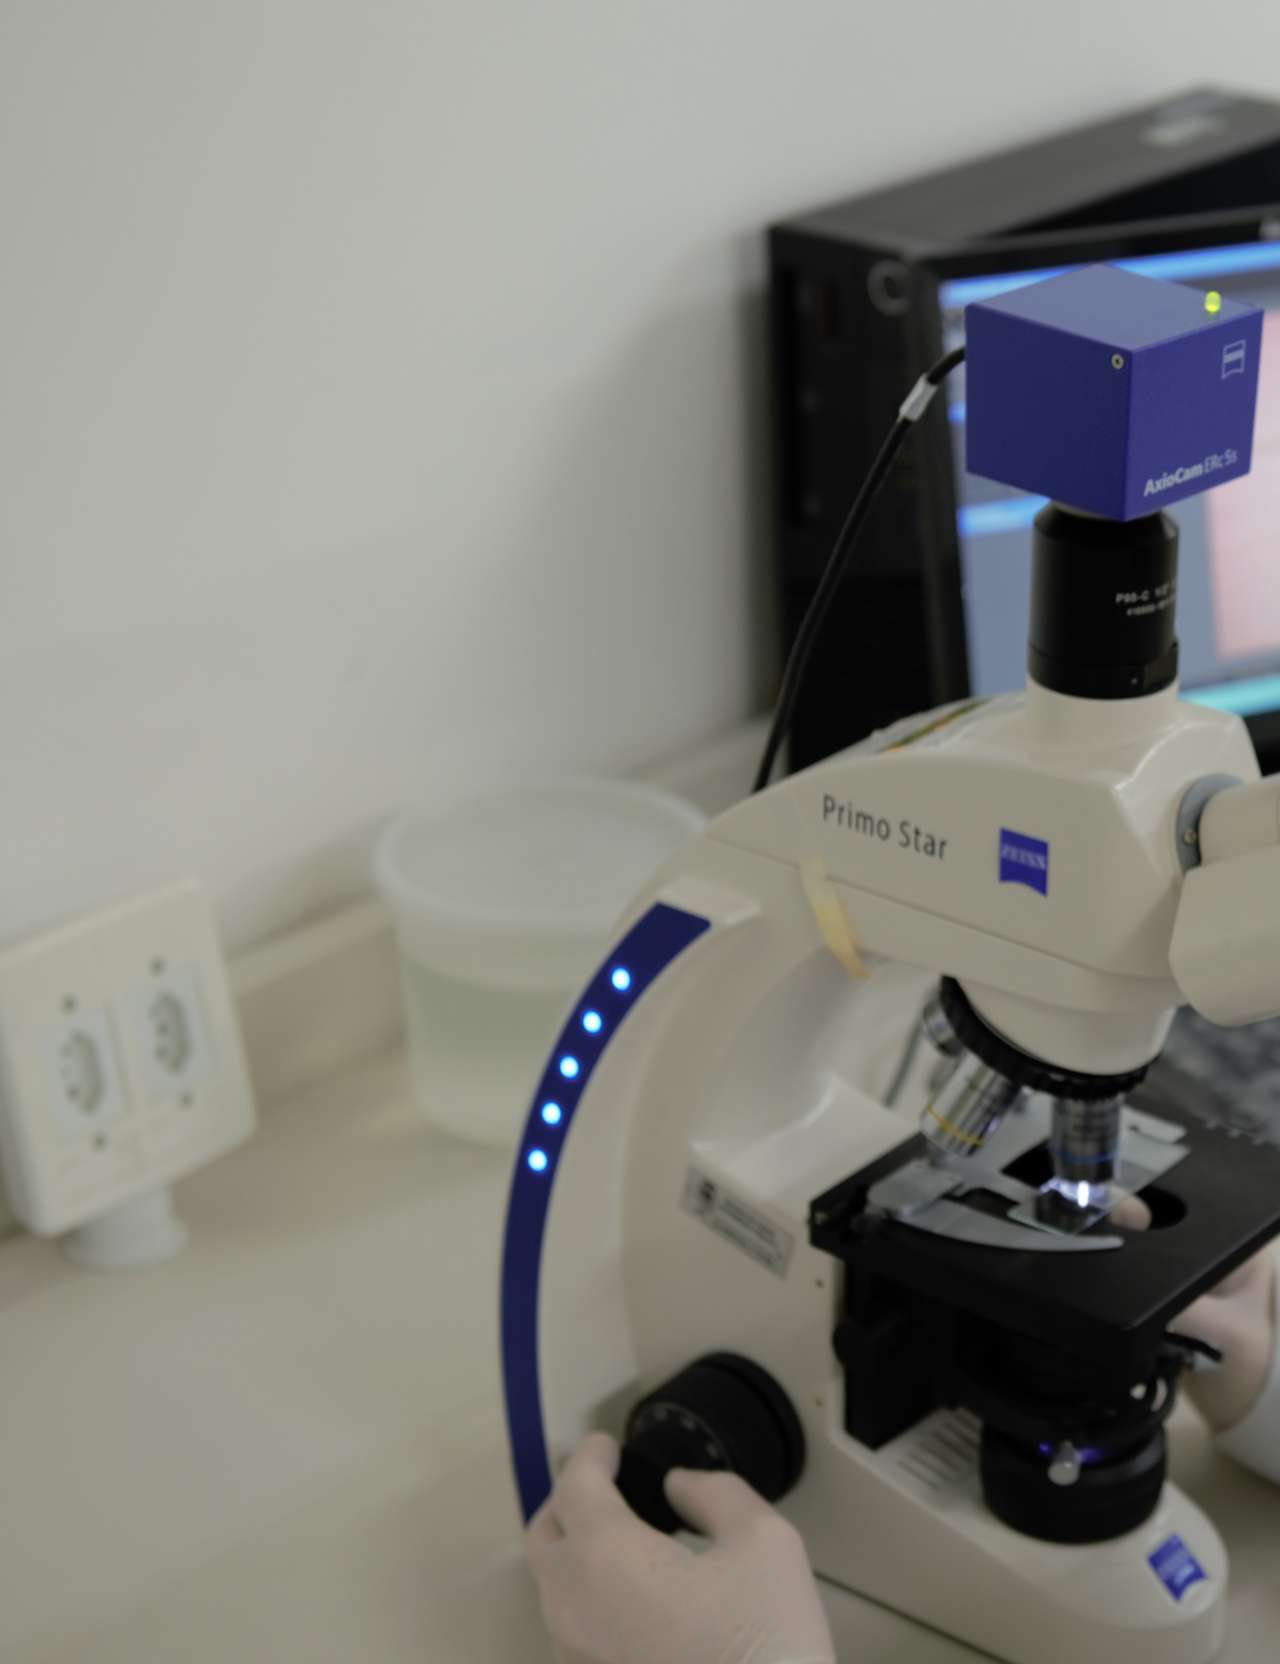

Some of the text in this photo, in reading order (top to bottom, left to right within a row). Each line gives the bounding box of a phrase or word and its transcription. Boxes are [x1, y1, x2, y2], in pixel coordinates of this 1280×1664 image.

[1144, 464, 1203, 496] AxioCam
[822, 793, 948, 861] Primo Star
